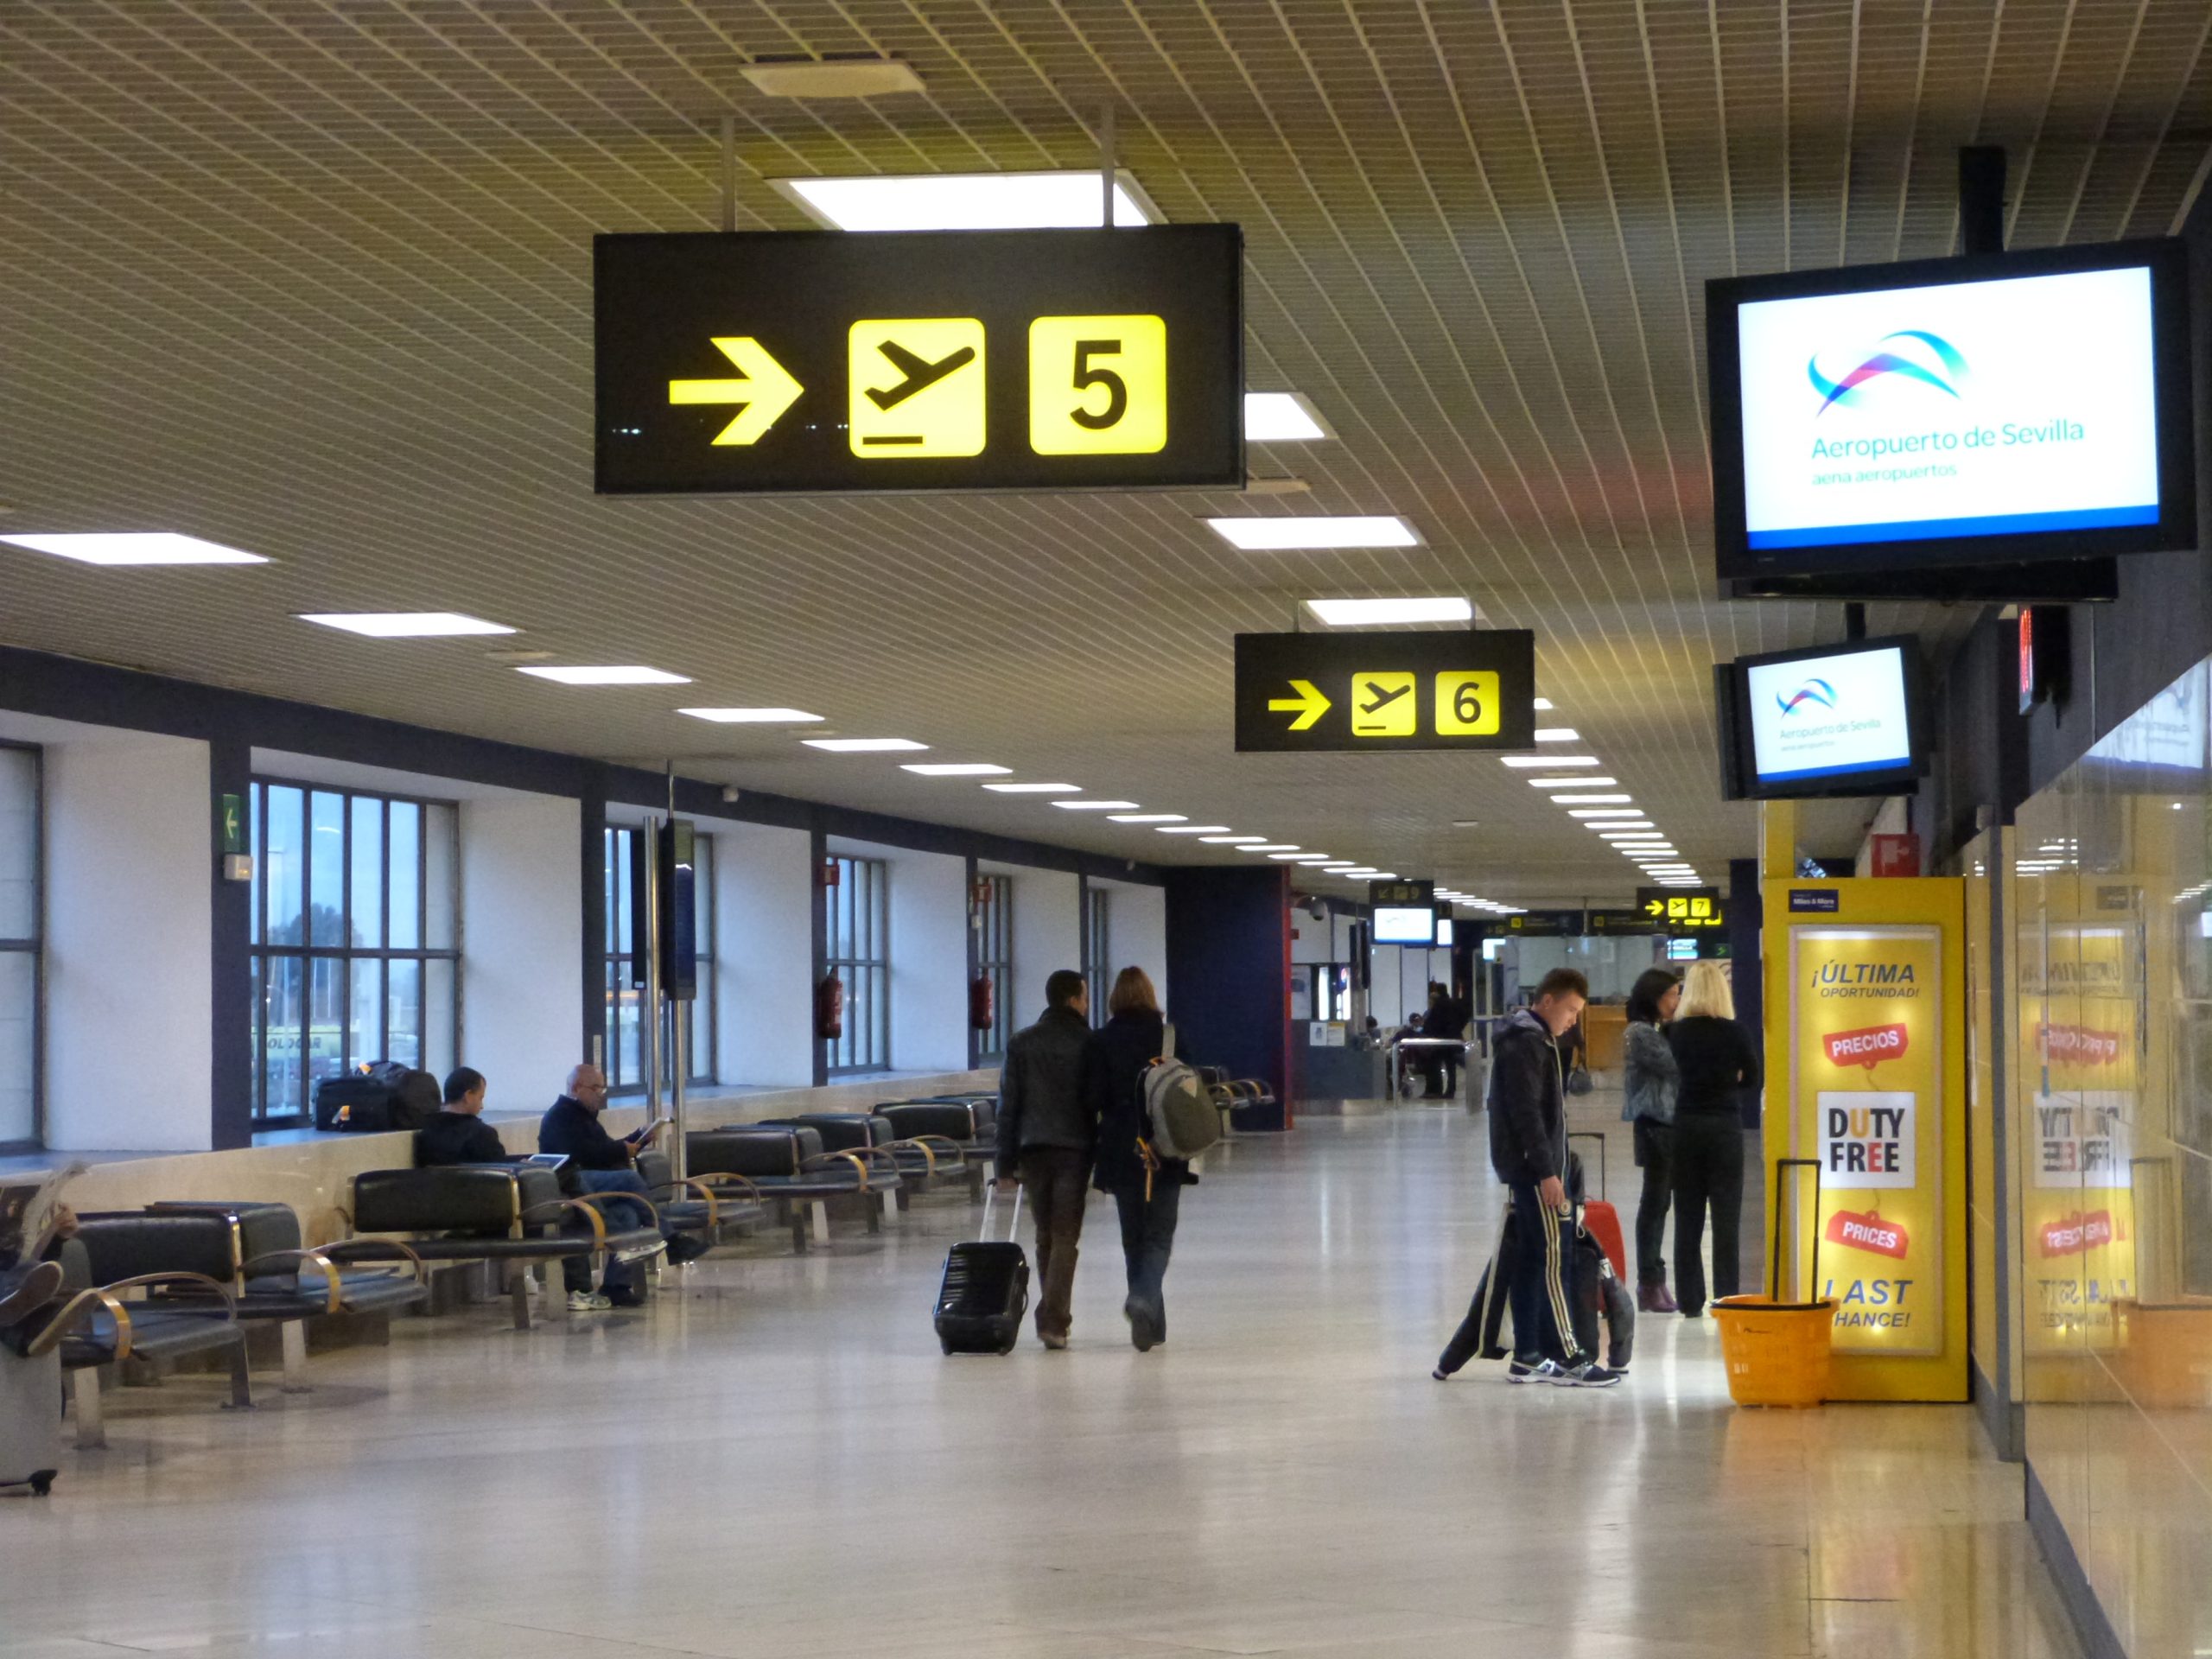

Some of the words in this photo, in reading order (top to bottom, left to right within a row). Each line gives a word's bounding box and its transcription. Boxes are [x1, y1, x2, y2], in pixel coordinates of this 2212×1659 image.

[1070, 340, 1128, 430] 5
[1812, 431, 1958, 461] Aeropuerto
[1964, 426, 1996, 448] de
[2002, 419, 2085, 446] Sevilla
[1812, 470, 1852, 486] aena
[1855, 463, 1957, 483] aeropuertos
[1453, 682, 1481, 724] 6
[1780, 726, 1834, 739] Aeropuerto
[1836, 723, 1849, 733] de
[1851, 719, 1881, 731] Sevilla
[1697, 901, 1705, 912] 7
[1811, 959, 1915, 988] ¡ÚLTIMA
[1821, 988, 1920, 998] OPORTUNIDAD!
[1832, 1030, 1899, 1057] PRECIOS
[1828, 1108, 1905, 1139] DUTY
[1830, 1142, 1900, 1173] FREE
[1842, 1221, 1897, 1249] PRICES
[1834, 1313, 1910, 1327] HANCE!
